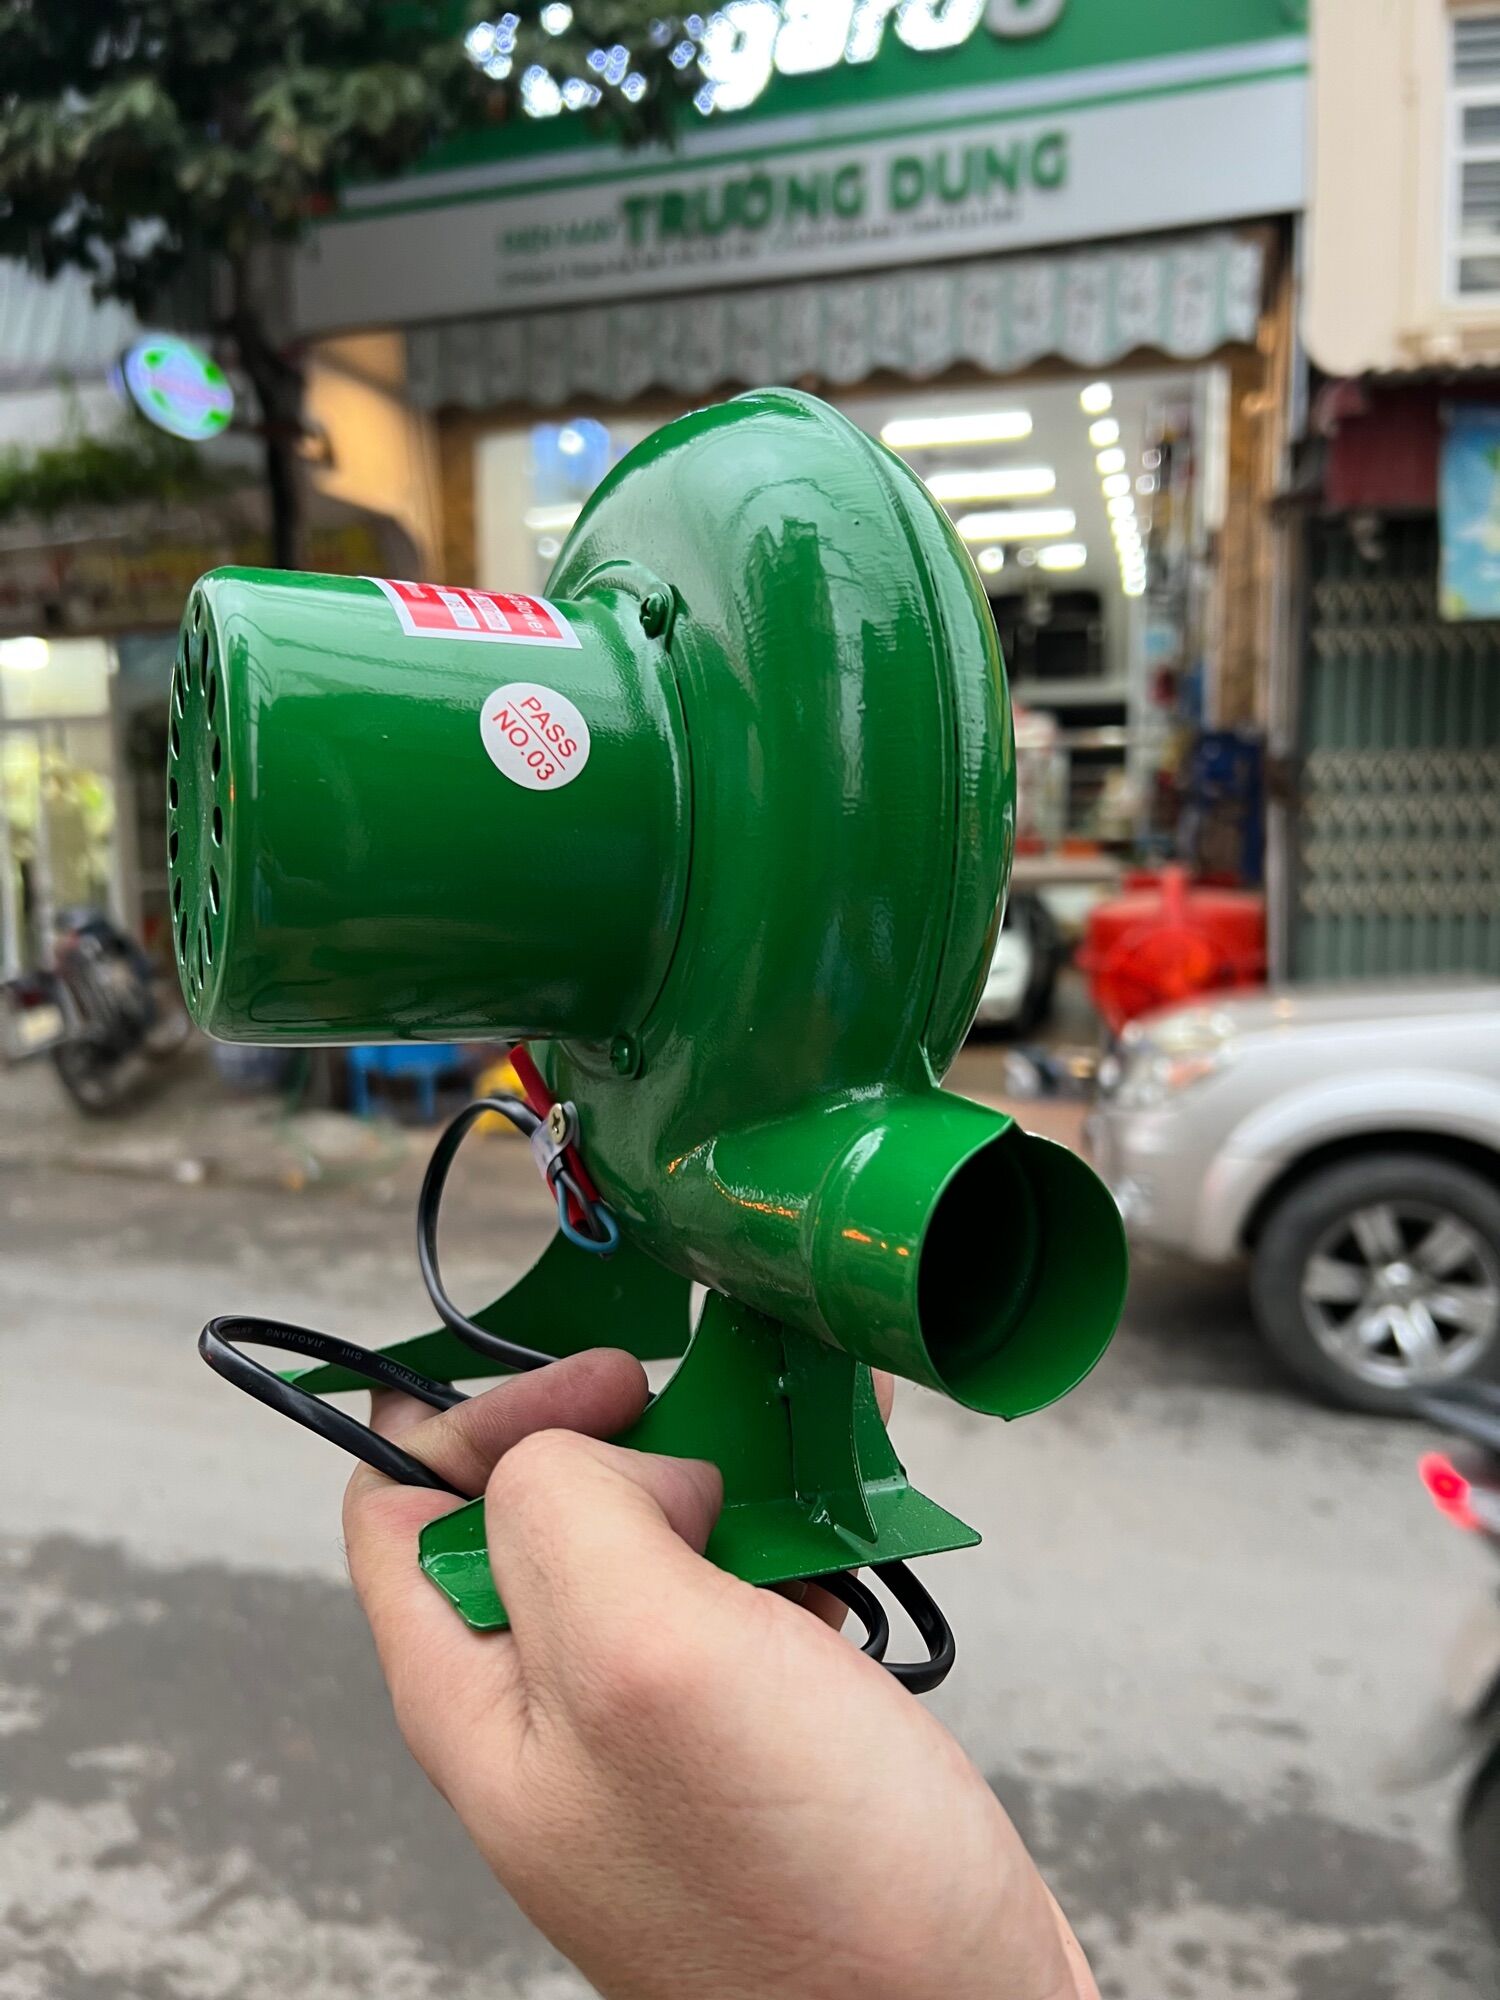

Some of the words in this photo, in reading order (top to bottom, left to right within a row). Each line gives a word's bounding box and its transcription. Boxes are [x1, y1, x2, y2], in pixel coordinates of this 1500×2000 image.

[888, 131, 1069, 212] DUNG
[492, 709, 556, 781] NO.03
[519, 696, 578, 758] PASS
